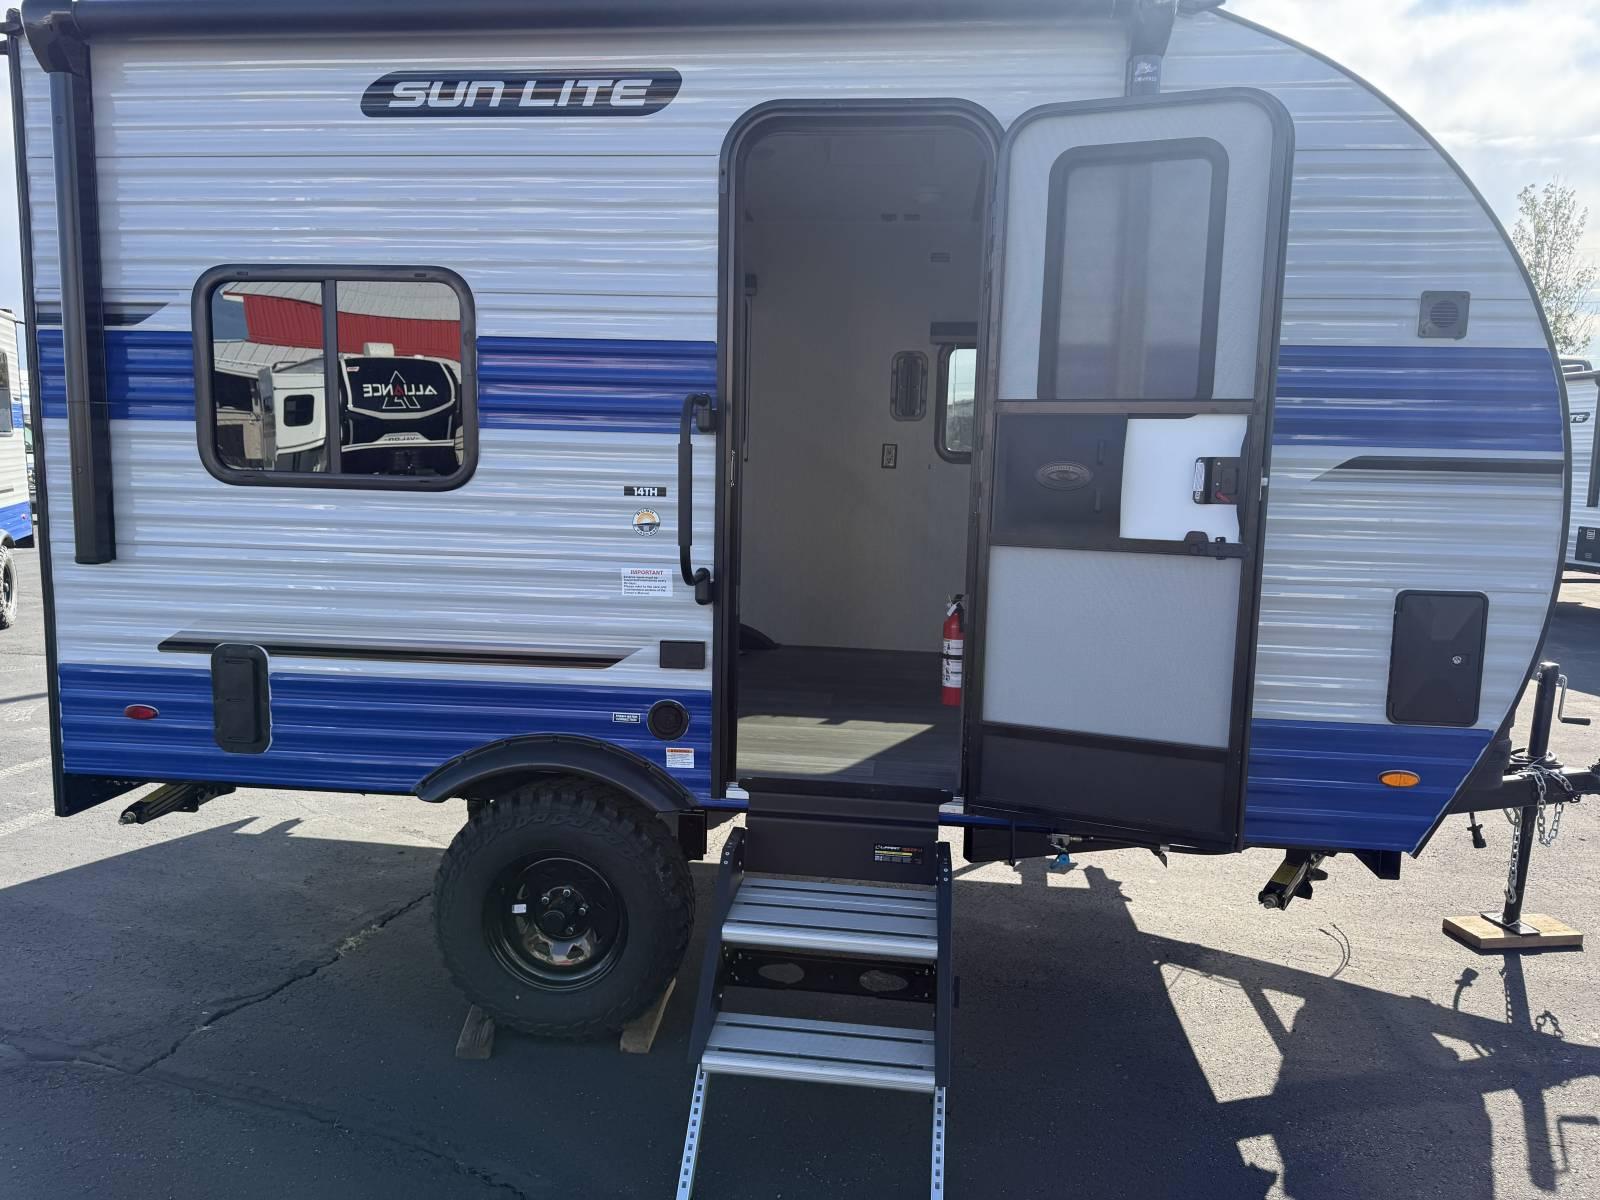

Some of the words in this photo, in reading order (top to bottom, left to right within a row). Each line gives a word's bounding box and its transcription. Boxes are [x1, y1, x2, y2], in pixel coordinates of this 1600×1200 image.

[388, 80, 505, 108] SUN
[518, 79, 653, 107] LITE
[633, 487, 658, 497] 14TH
